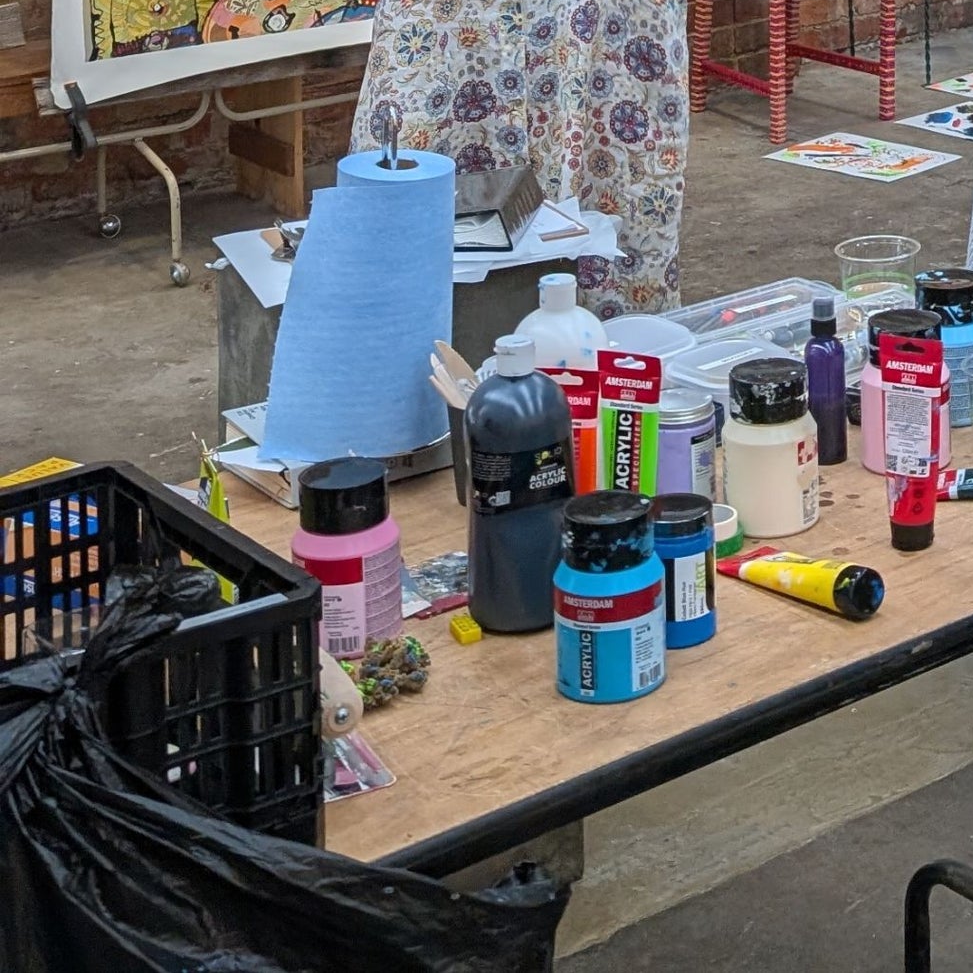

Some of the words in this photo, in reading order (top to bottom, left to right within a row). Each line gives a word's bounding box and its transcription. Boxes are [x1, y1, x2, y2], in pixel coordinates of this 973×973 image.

[886, 360, 934, 375] AMSTERDAM
[605, 376, 653, 390] AMSTERDAM
[615, 413, 633, 490] ACRYLIC
[632, 419, 641, 486] SPECIALTIES
[530, 466, 566, 482] ACRYLIC
[529, 475, 567, 489] COLOUR
[564, 595, 614, 609] AMSTERDAM
[581, 630, 593, 688] ACRYLIC
